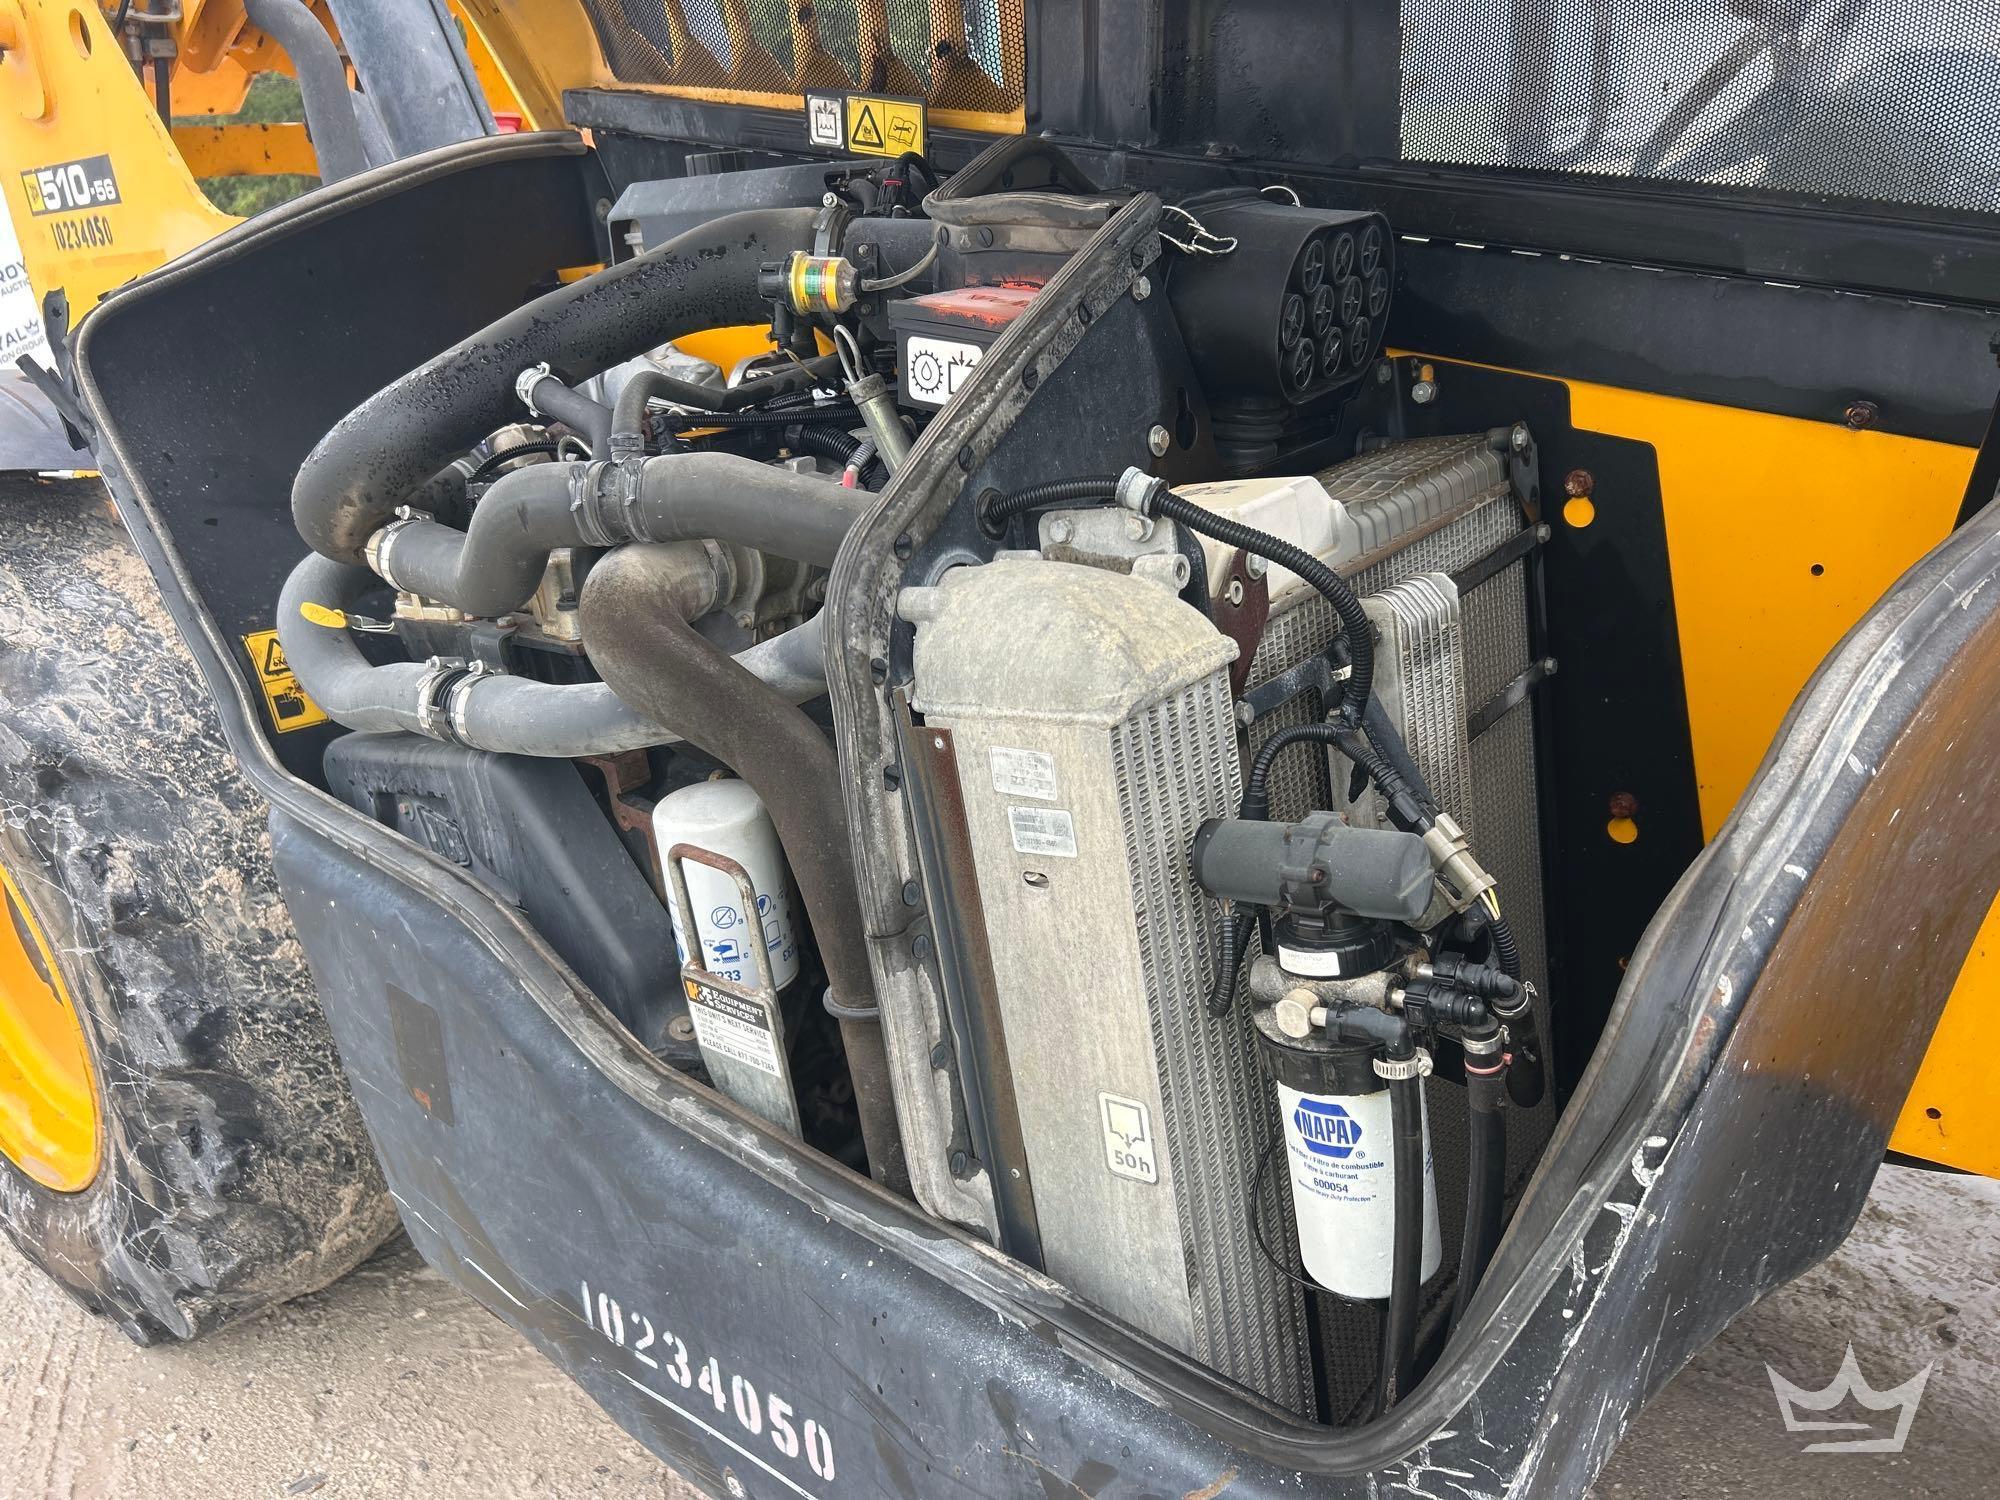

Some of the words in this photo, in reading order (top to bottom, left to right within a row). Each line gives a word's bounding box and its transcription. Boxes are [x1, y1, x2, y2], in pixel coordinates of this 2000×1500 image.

[50, 215, 114, 251] 10234050
[712, 989, 764, 1017] EQUIPMENT
[715, 1000, 756, 1023] SERVICES
[742, 1023, 768, 1040] SERVICE
[702, 1037, 724, 1051] PLEASE
[723, 1045, 738, 1057] CALL
[1301, 1110, 1351, 1145] NAPA
[1324, 1170, 1359, 1180] carburant
[1330, 1161, 1340, 1170] de
[1341, 1161, 1385, 1171] combustible
[1313, 1177, 1349, 1194] 600054
[580, 1279, 836, 1482] 10234050
